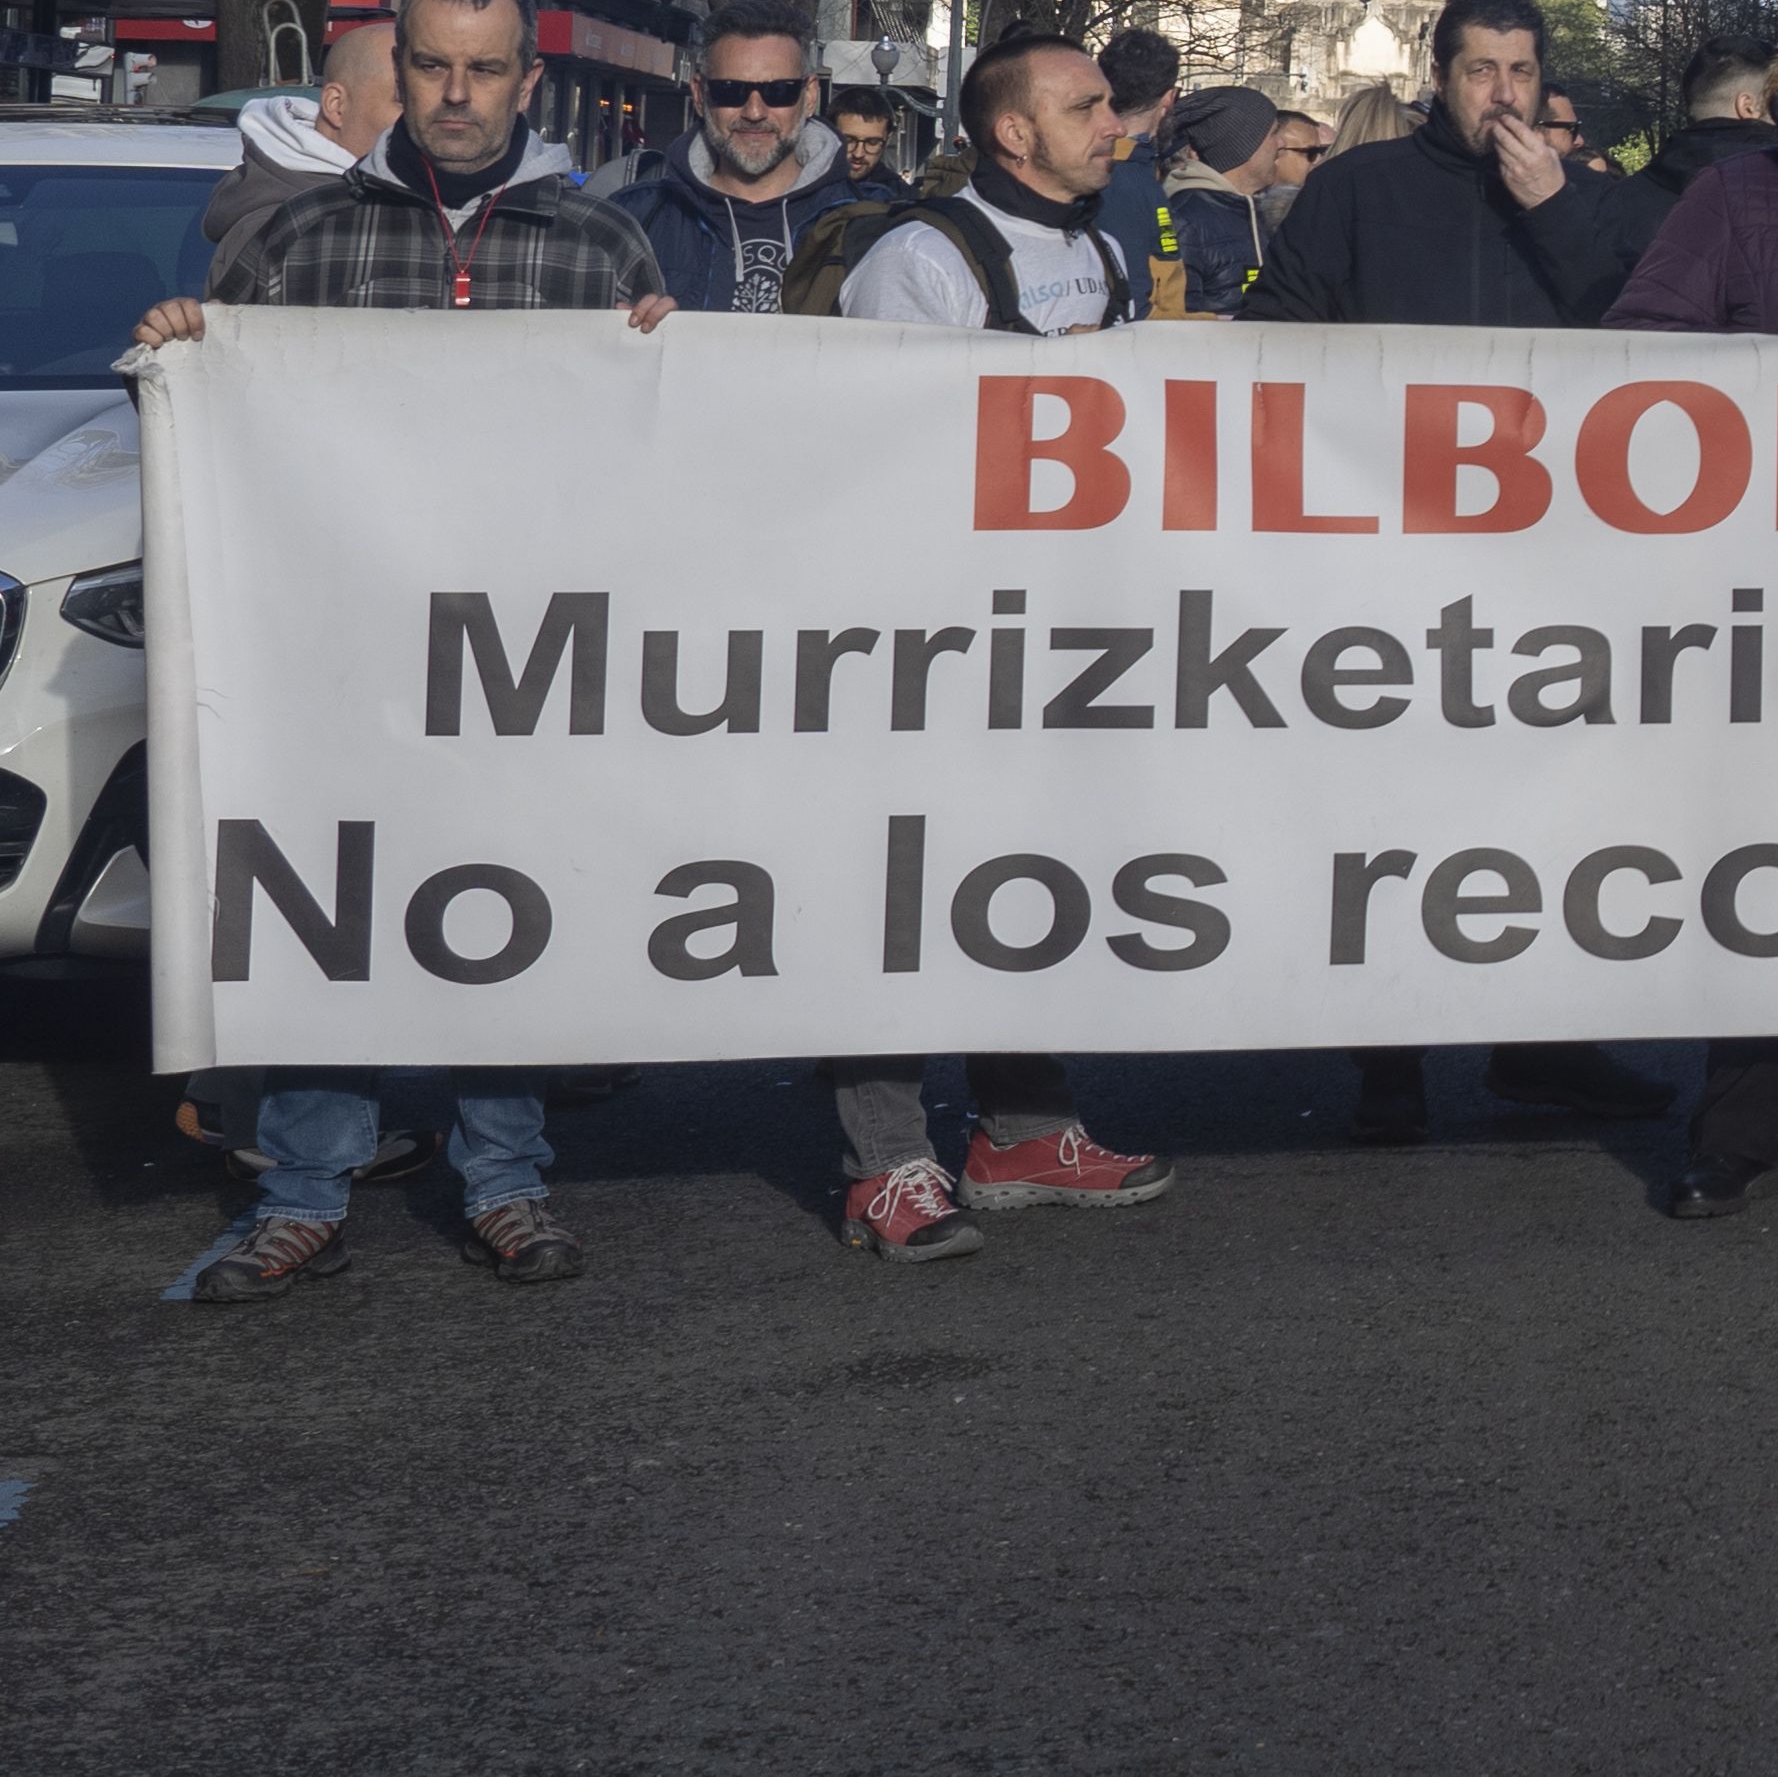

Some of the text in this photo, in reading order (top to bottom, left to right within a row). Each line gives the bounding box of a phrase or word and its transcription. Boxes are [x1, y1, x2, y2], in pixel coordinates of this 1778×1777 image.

[210, 818, 552, 986] No
[646, 860, 780, 982] a
[881, 814, 1232, 974] los
